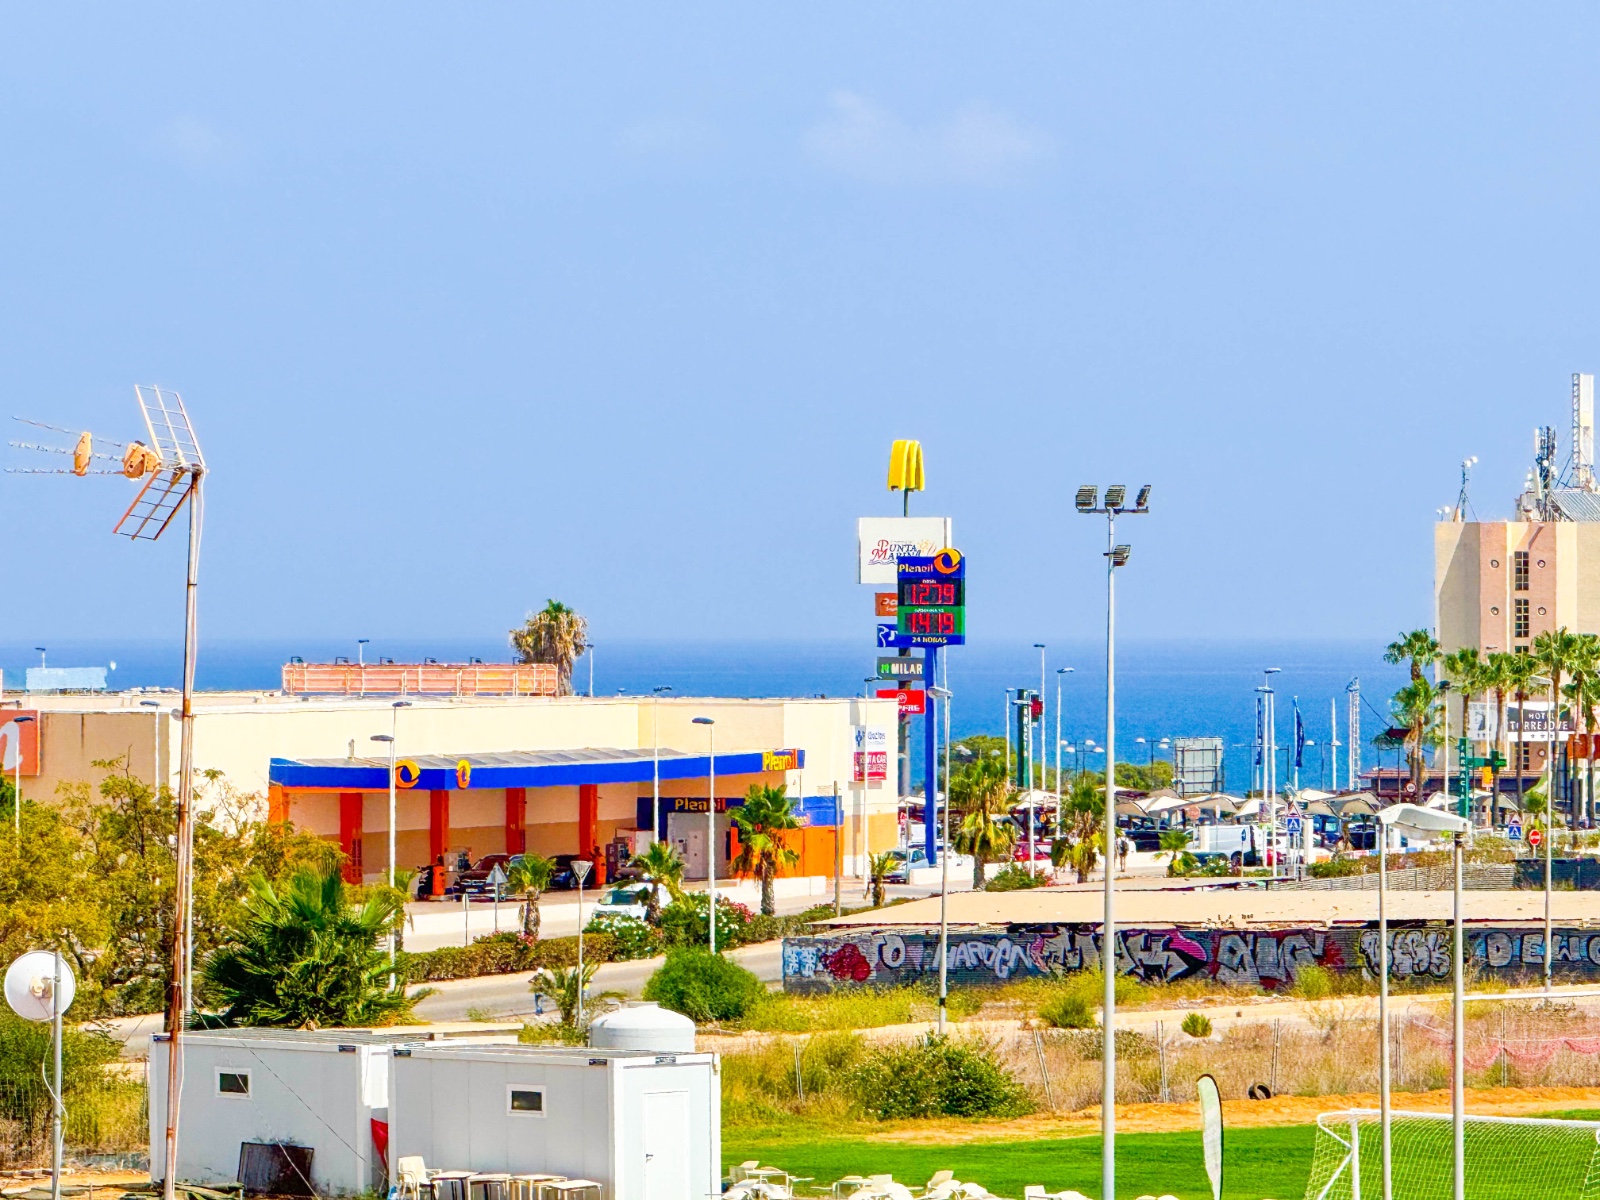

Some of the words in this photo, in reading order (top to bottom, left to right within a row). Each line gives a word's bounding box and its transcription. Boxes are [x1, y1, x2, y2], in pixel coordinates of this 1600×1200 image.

[898, 564, 933, 573] Plenoil
[891, 663, 923, 675] MILAR
[898, 704, 920, 712] PFRE
[1528, 712, 1555, 720] HOTL
[762, 748, 798, 771] Plenoil
